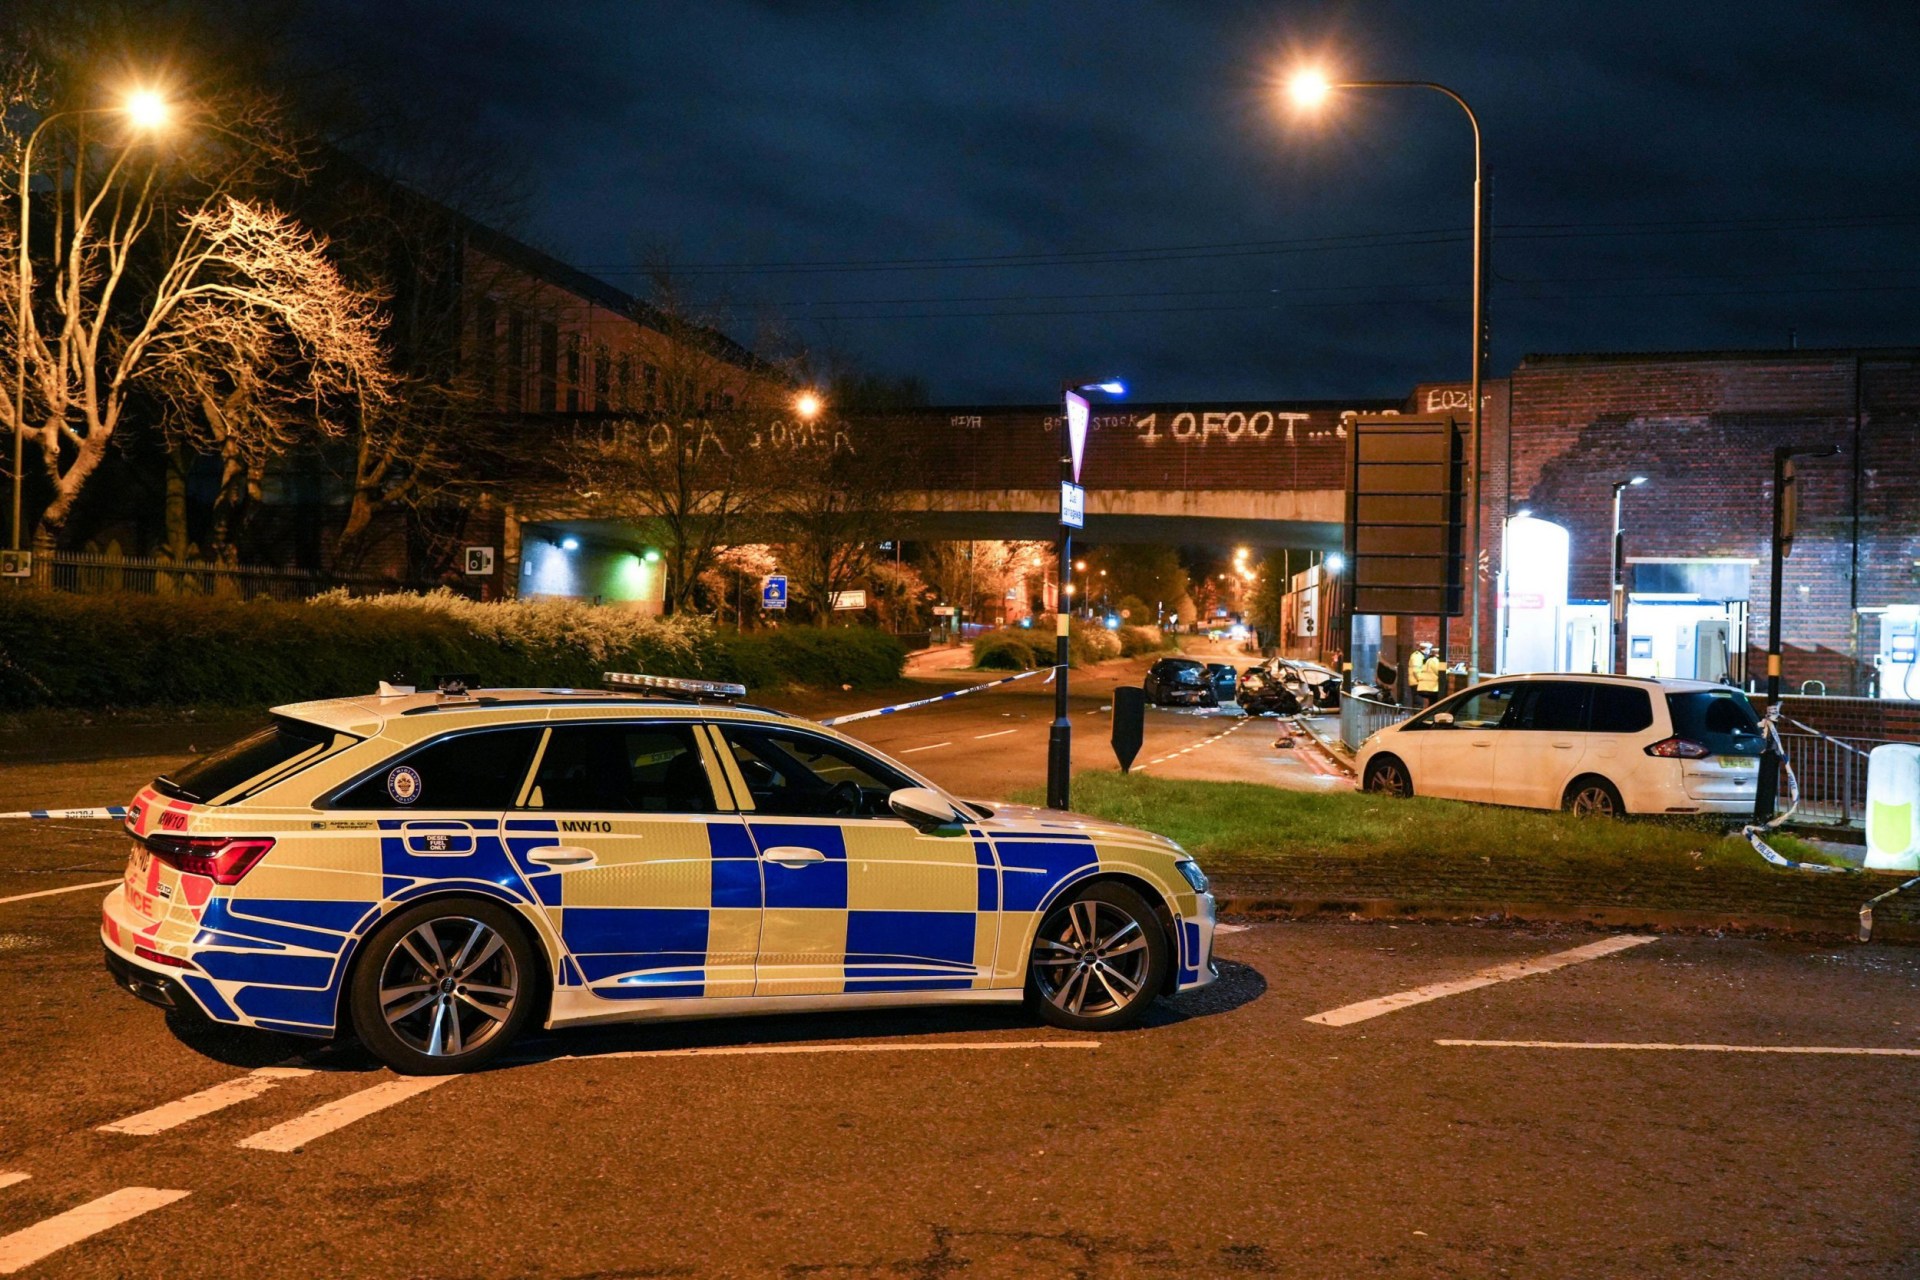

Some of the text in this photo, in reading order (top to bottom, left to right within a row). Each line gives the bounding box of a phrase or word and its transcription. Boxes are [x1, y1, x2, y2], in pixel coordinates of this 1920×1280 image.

[157, 811, 186, 830] MW10
[562, 821, 611, 833] MW10
[1756, 842, 1777, 861] POLICE
